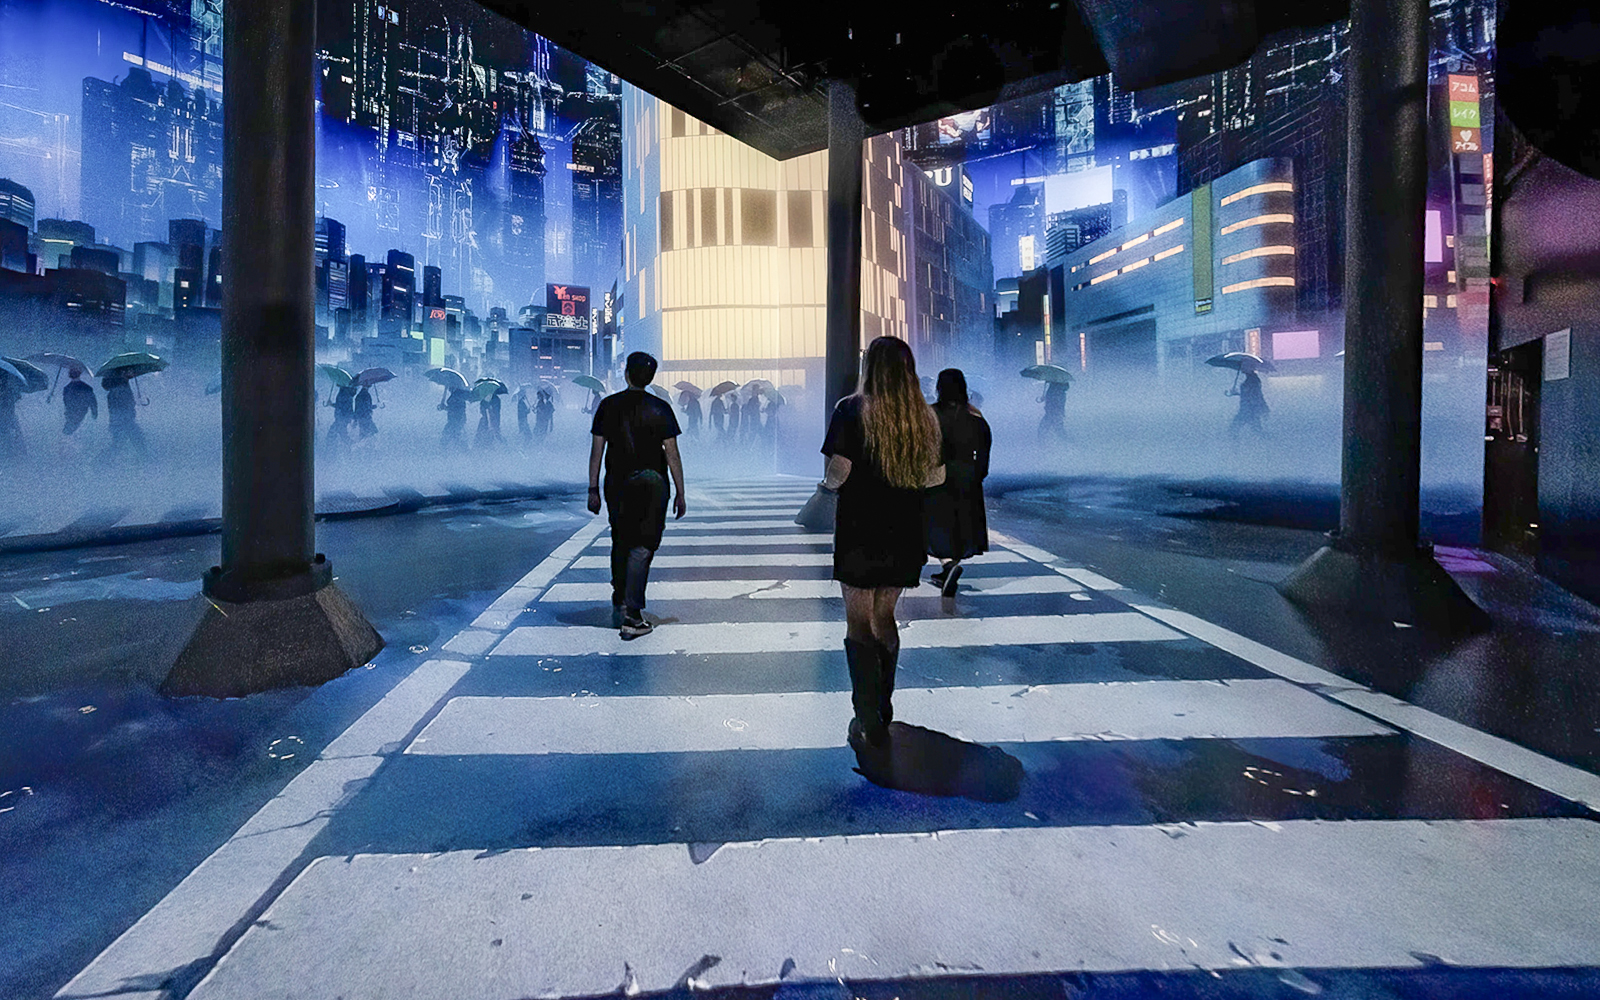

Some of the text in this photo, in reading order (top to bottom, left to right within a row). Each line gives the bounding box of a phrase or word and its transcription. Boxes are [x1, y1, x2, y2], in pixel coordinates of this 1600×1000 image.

[1452, 81, 1476, 93] アコム
[1453, 107, 1477, 119] レイク
